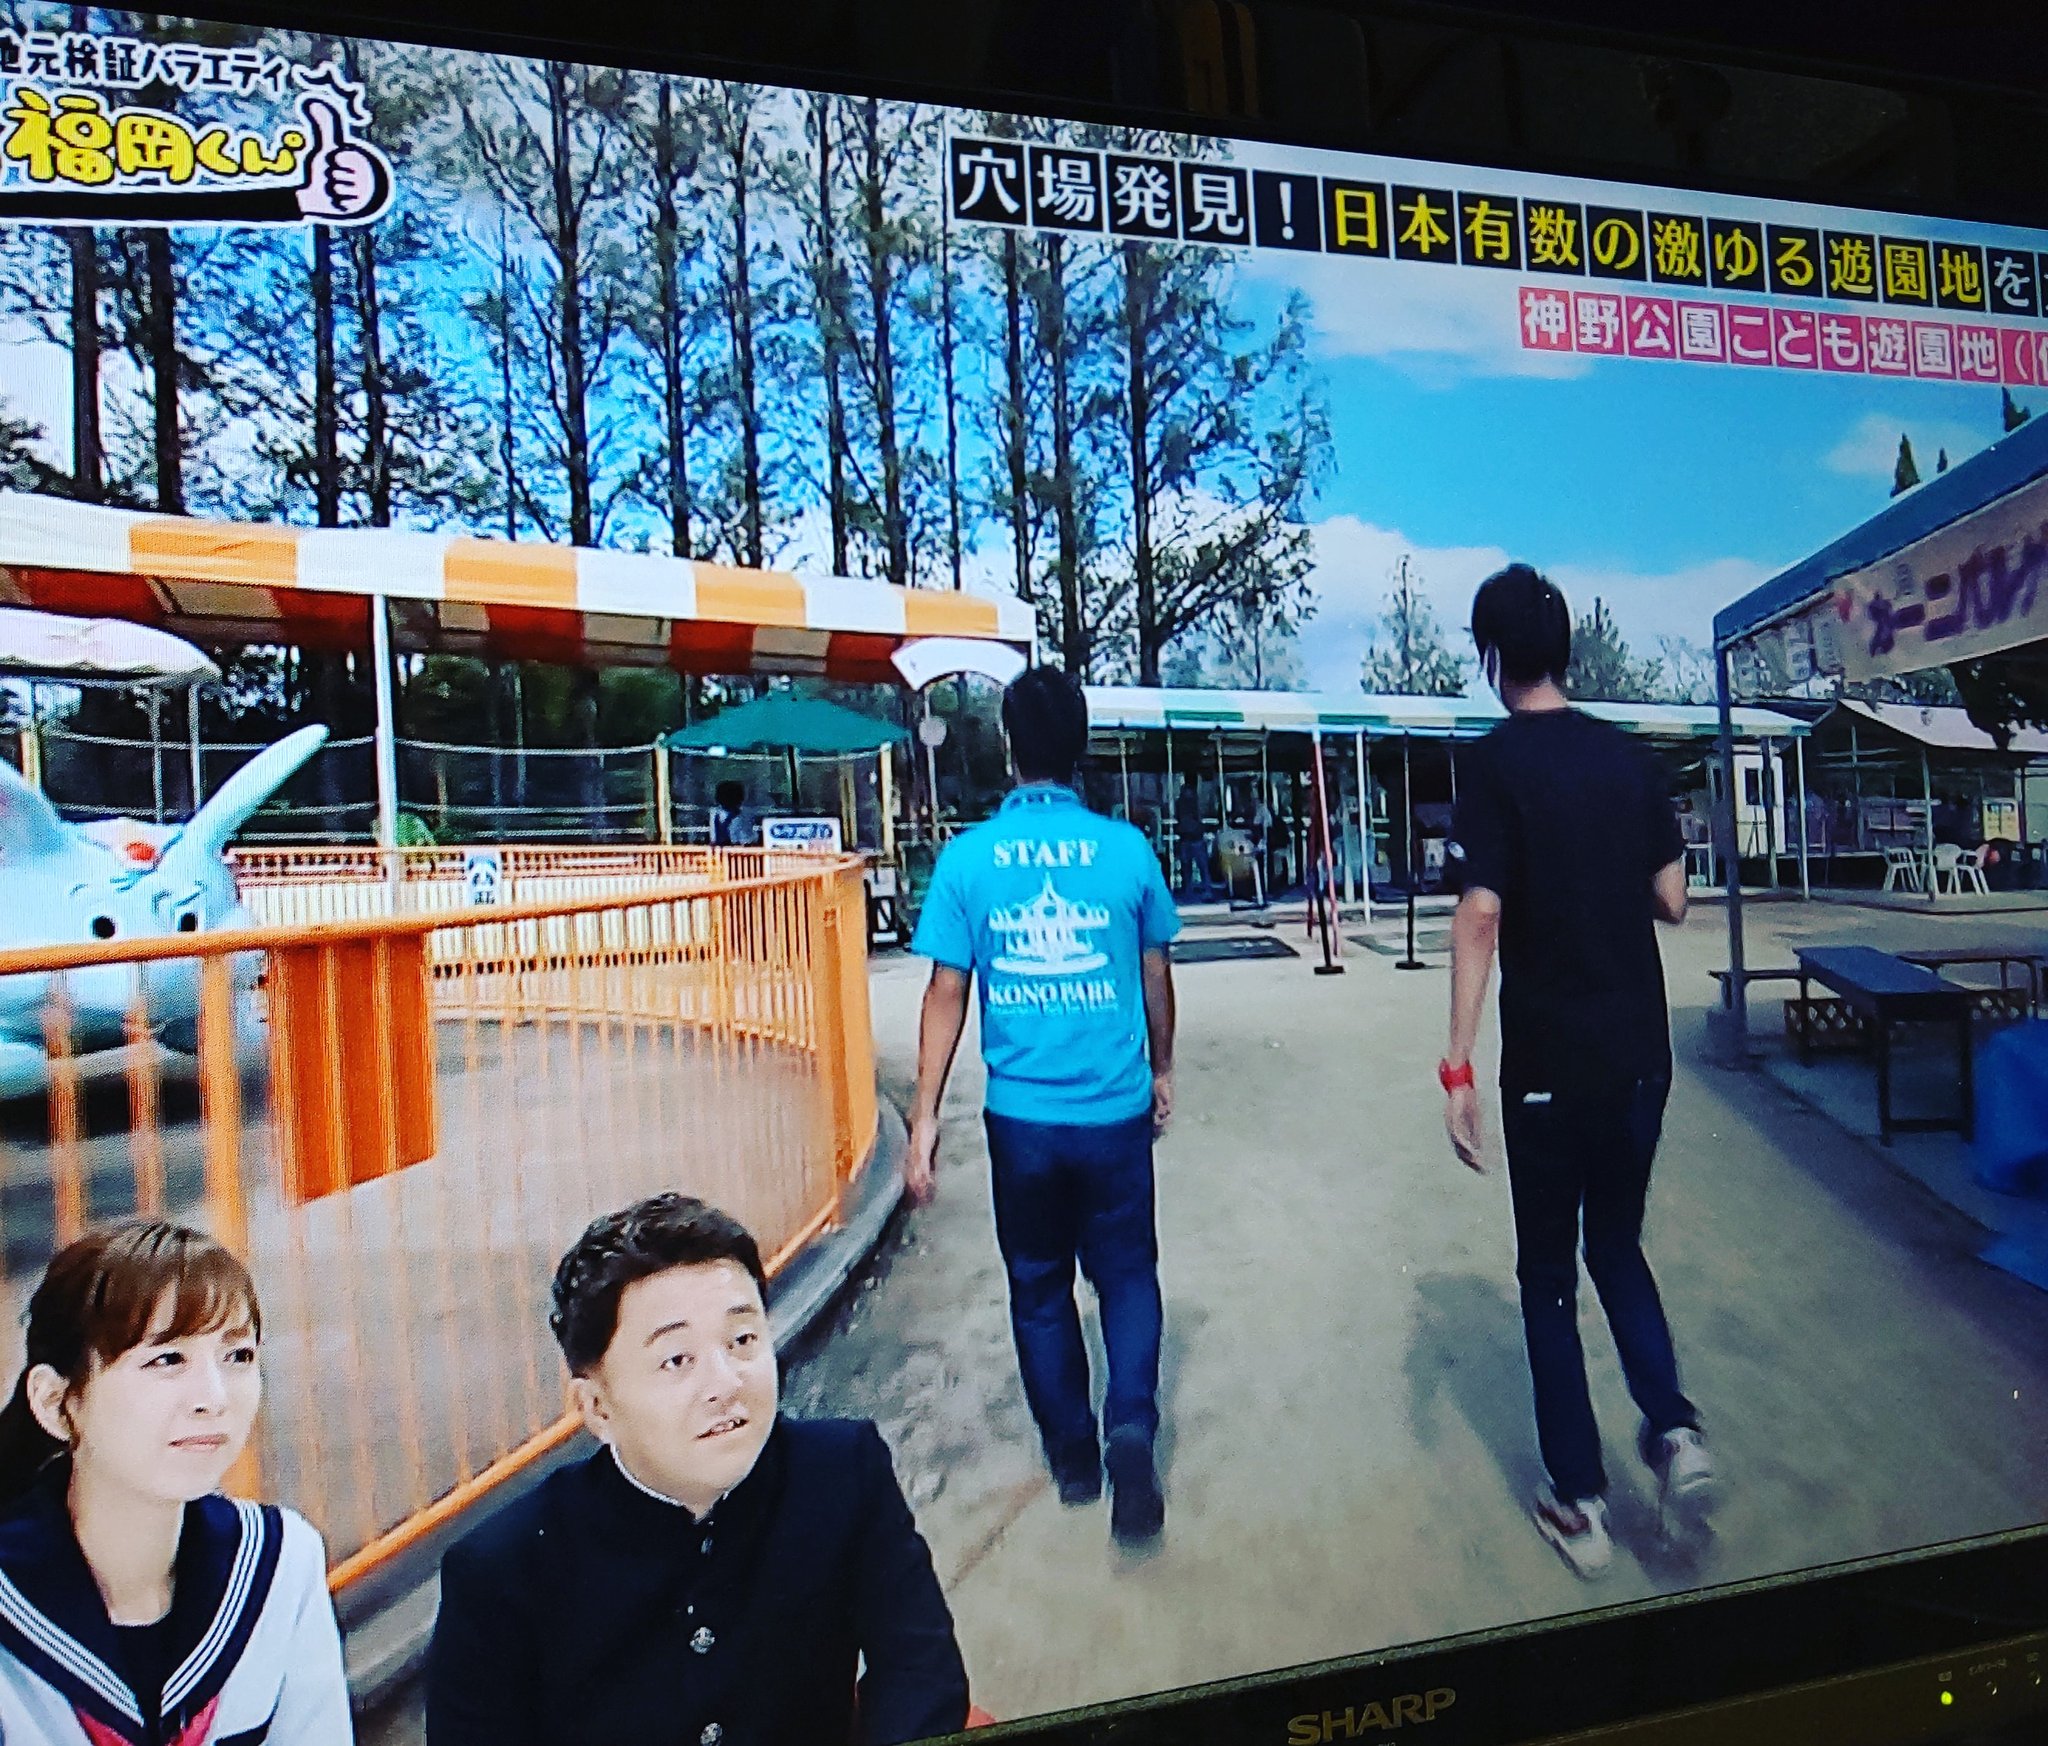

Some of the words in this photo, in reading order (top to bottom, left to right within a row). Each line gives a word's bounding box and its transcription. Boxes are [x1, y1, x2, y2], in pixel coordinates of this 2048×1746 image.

[958, 147, 2048, 309] 穴場発見！日本有数の激ゆる遊園地を
[1523, 293, 2048, 381] 神野公園こども遊園地（
[992, 838, 1098, 869] STAFF
[1286, 1687, 1457, 1746] SHARP
